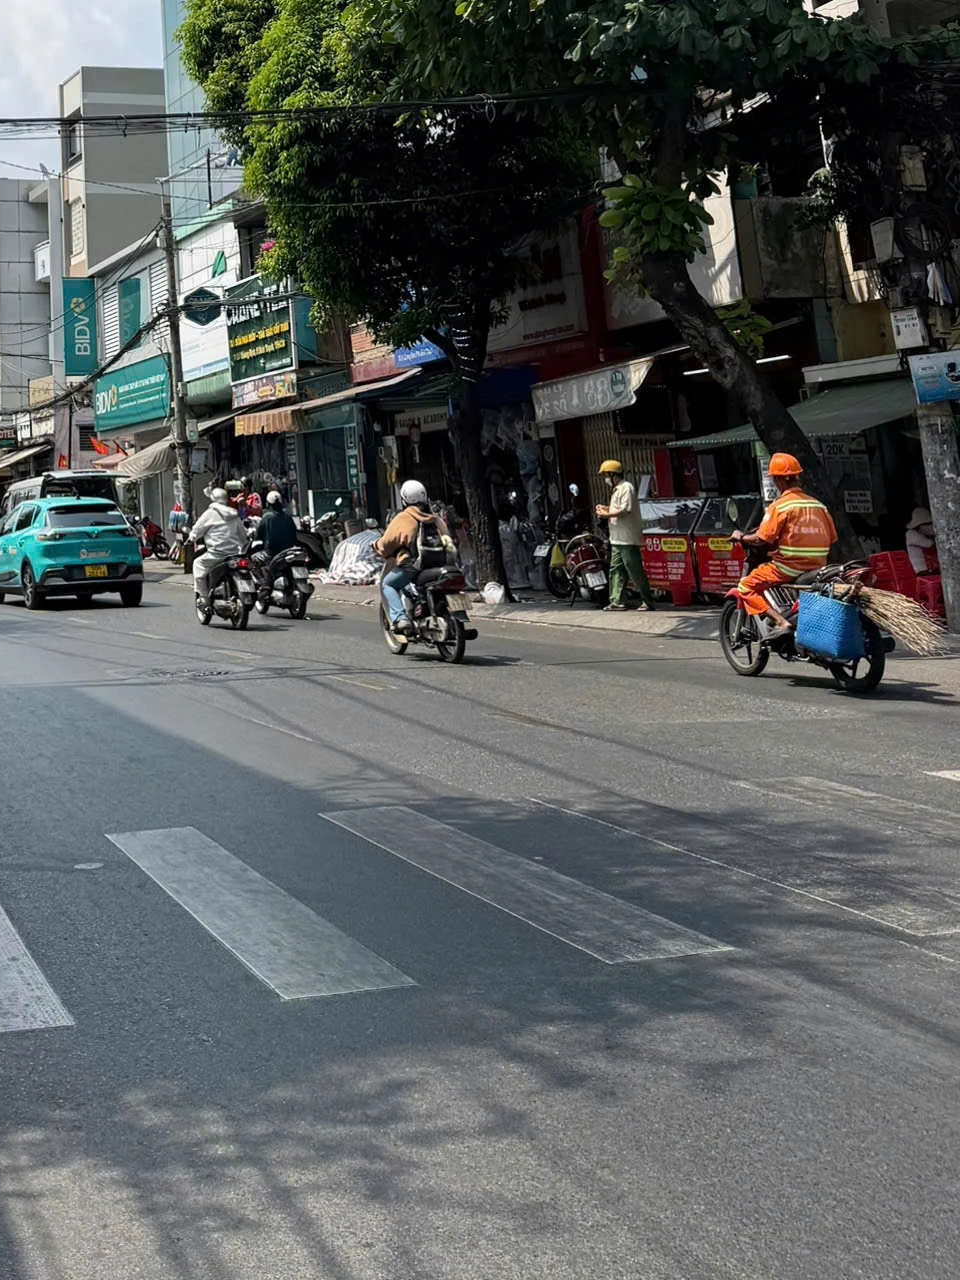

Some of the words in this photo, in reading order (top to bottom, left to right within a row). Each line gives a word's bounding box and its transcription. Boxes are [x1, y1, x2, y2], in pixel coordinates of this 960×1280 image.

[74, 312, 90, 356] BIDV
[95, 390, 112, 415] BIDV
[825, 444, 845, 456] 20K
